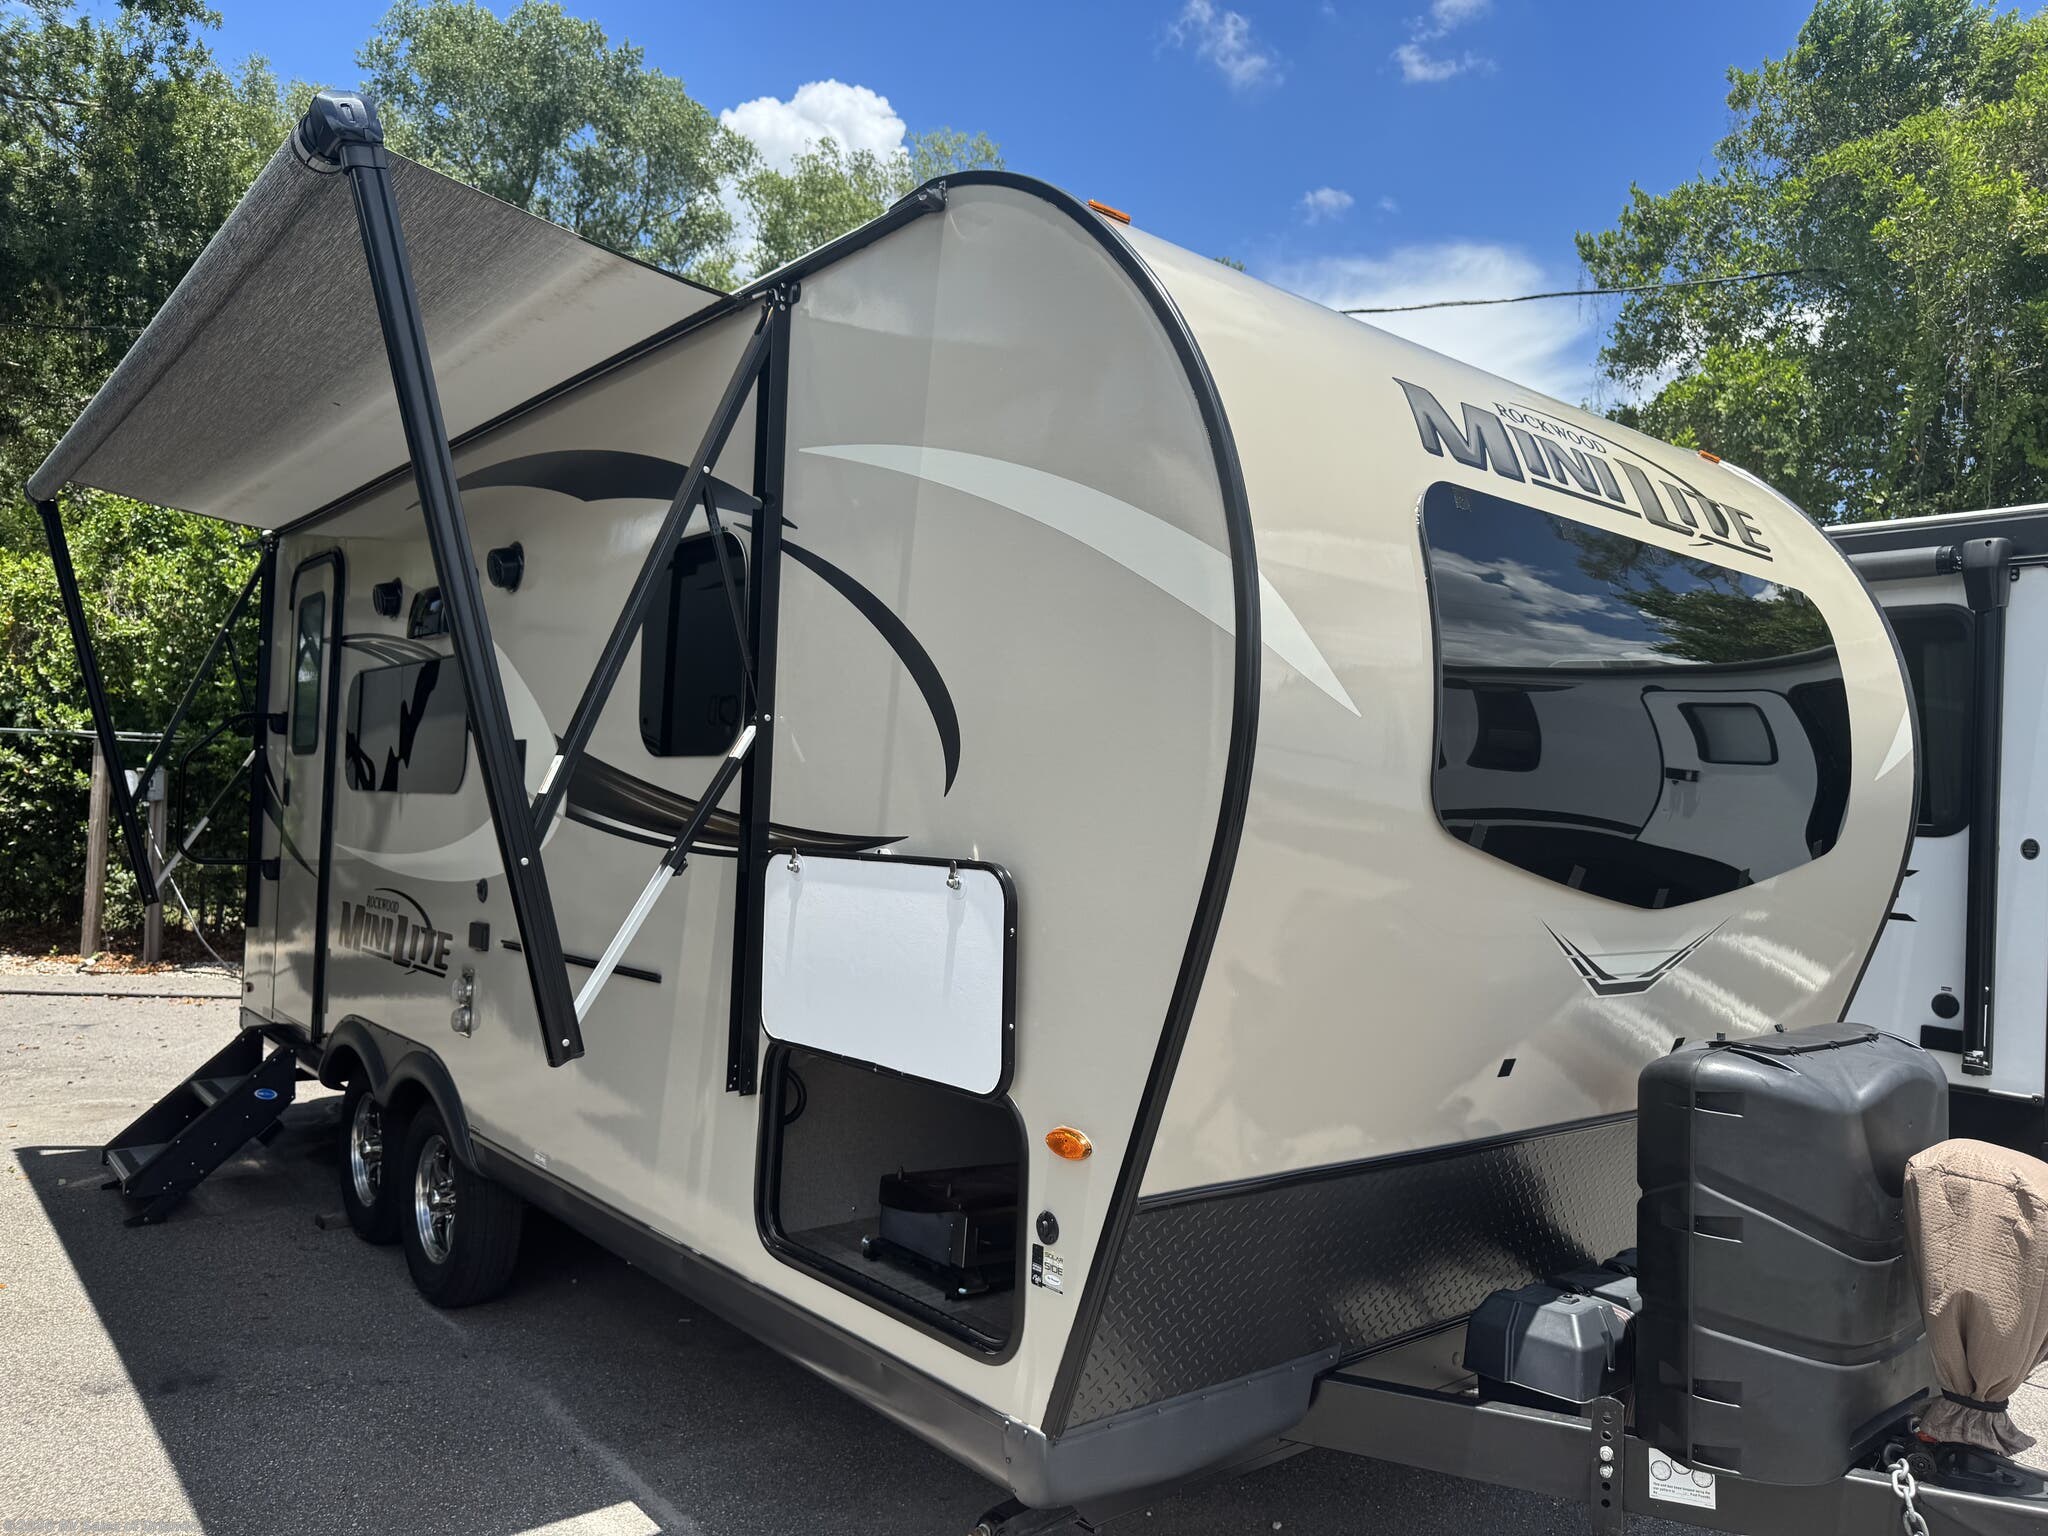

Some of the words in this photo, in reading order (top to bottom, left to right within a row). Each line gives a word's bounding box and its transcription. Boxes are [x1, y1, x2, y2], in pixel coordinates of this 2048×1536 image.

[1495, 402, 1607, 454] ROCKWOOD
[1392, 376, 1626, 505] MINI
[1613, 457, 1772, 554] LITE
[366, 894, 400, 914] ROCKWOOD
[338, 900, 394, 953] MINI
[392, 914, 454, 971] LITE
[1044, 1261, 1064, 1277] SIDE
